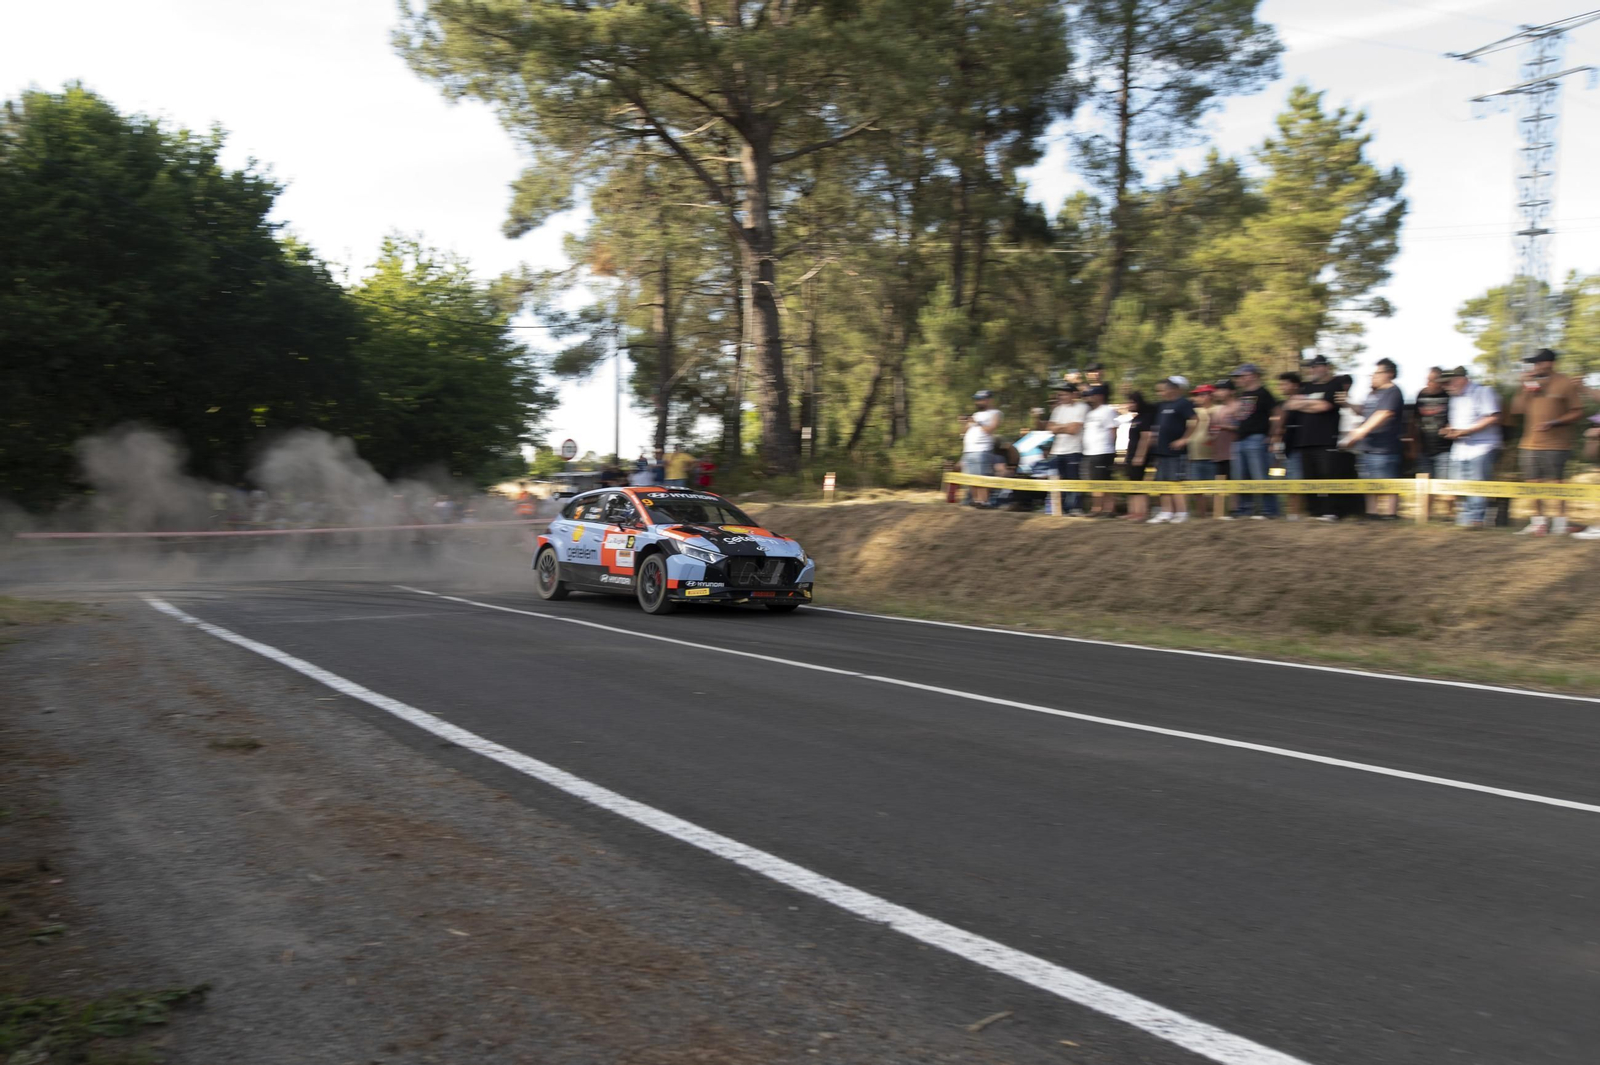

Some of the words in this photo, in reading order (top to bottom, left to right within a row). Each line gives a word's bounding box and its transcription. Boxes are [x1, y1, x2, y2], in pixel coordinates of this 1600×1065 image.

[670, 493, 719, 501] HYUNDAI
[628, 536, 635, 548] 9
[567, 545, 598, 561] cetelem
